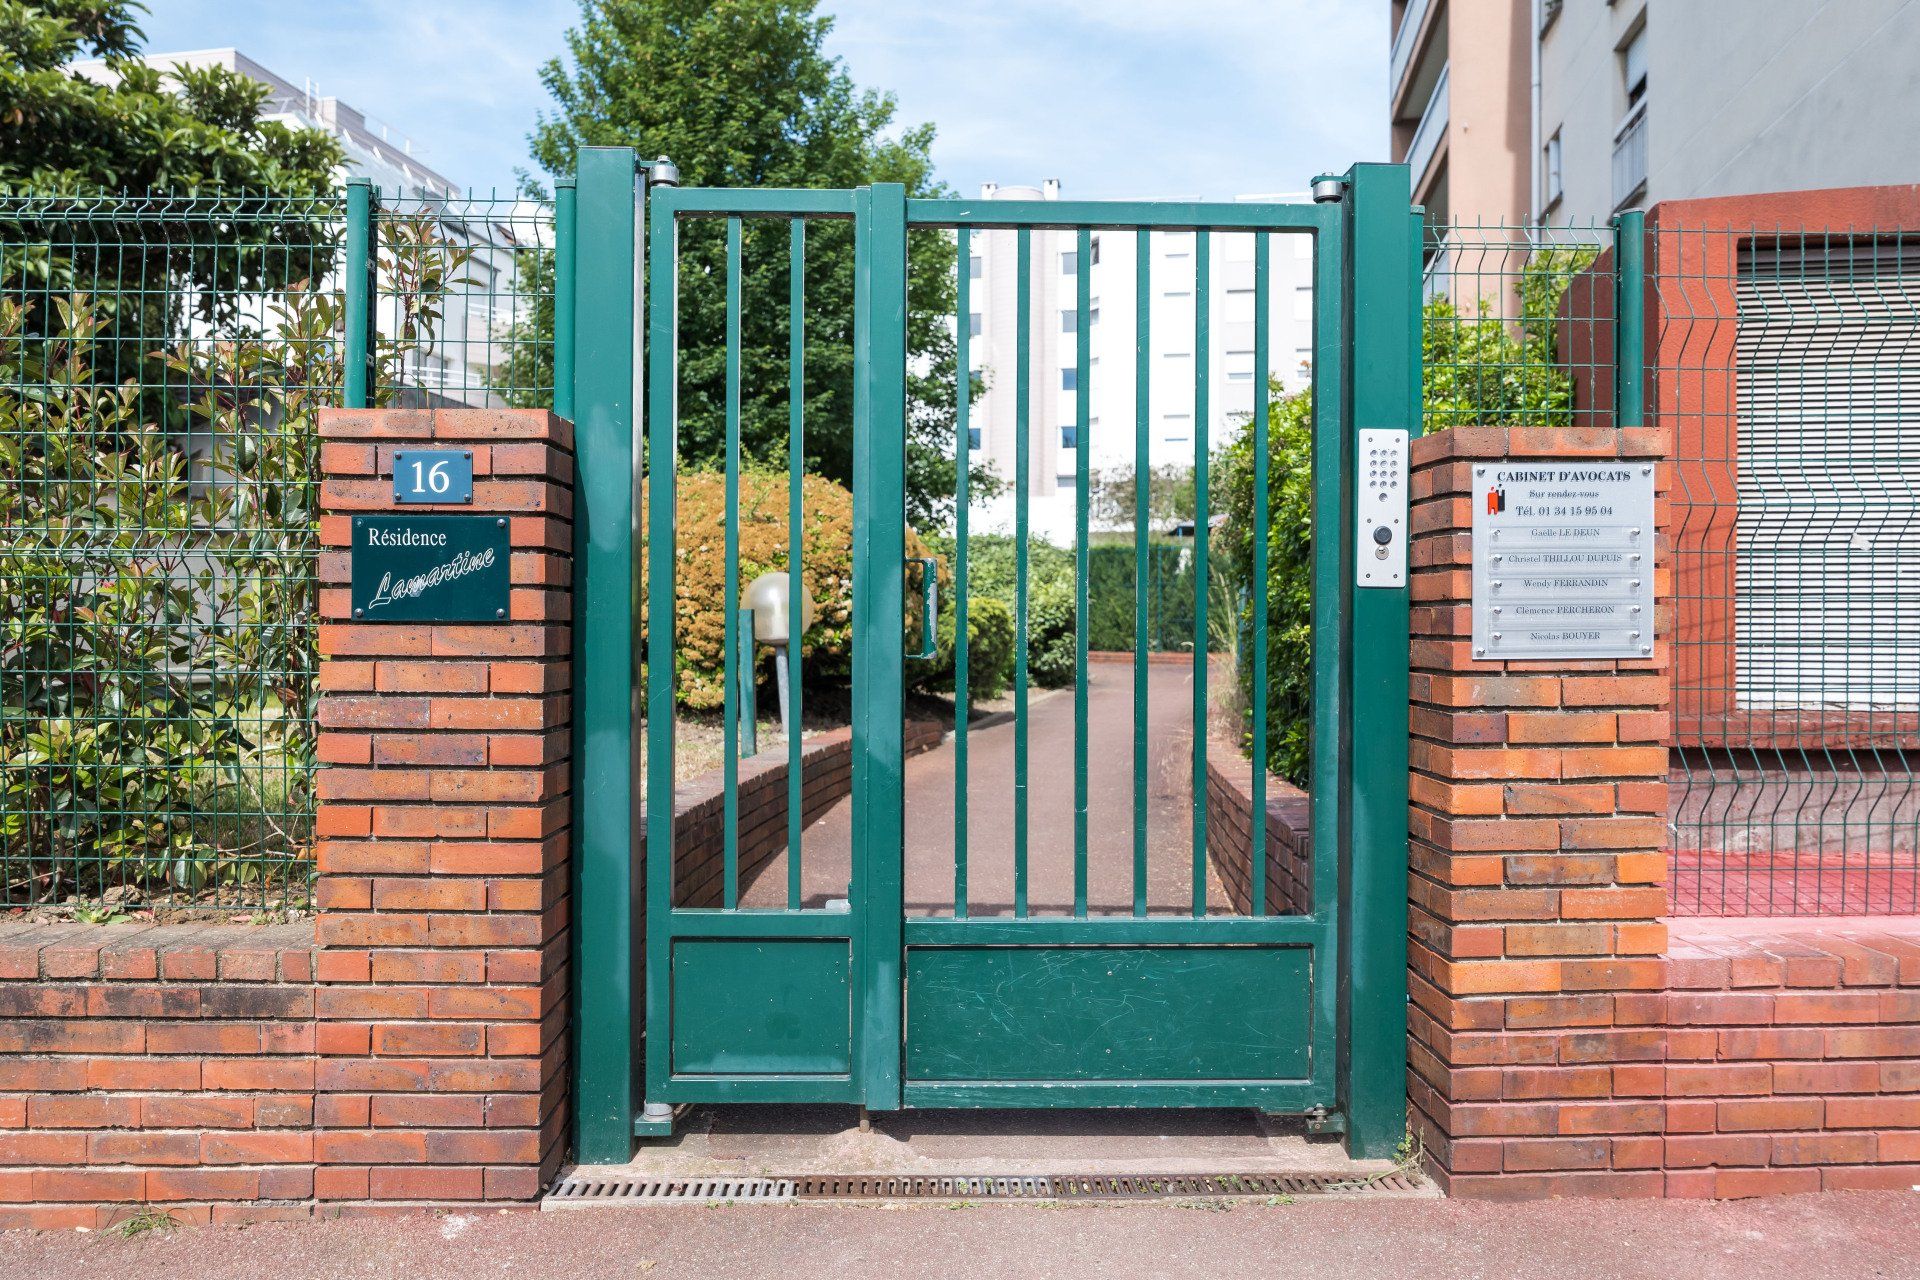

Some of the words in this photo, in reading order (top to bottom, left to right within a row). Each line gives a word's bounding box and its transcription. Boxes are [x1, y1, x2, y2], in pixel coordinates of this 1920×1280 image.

[411, 460, 450, 493] 16
[1497, 470, 1556, 482] CABINET
[1559, 470, 1631, 482] D'AVOCATS
[1529, 489, 1546, 499] Sur
[1548, 489, 1600, 499] rendez-vous
[1516, 506, 1535, 516] Tél.
[1538, 506, 1551, 516] 01
[1554, 506, 1567, 516] 34
[1570, 506, 1582, 516] 15
[1585, 506, 1598, 516] 95
[1600, 506, 1613, 516] 04
[368, 528, 447, 546] Résidence
[1559, 528, 1571, 536] LE
[1573, 528, 1600, 537] DEUN
[1508, 554, 1541, 563] Christel
[1542, 554, 1585, 562] THILLOU
[1587, 554, 1622, 562] DUPUIS
[368, 548, 495, 609] Lamartine
[1524, 579, 1551, 589] Wendy
[1554, 578, 1608, 587] FERRANDIN
[1557, 605, 1615, 614] PERCHERON
[1530, 632, 1560, 640] Nicolas
[1562, 631, 1600, 640] BOUYER
